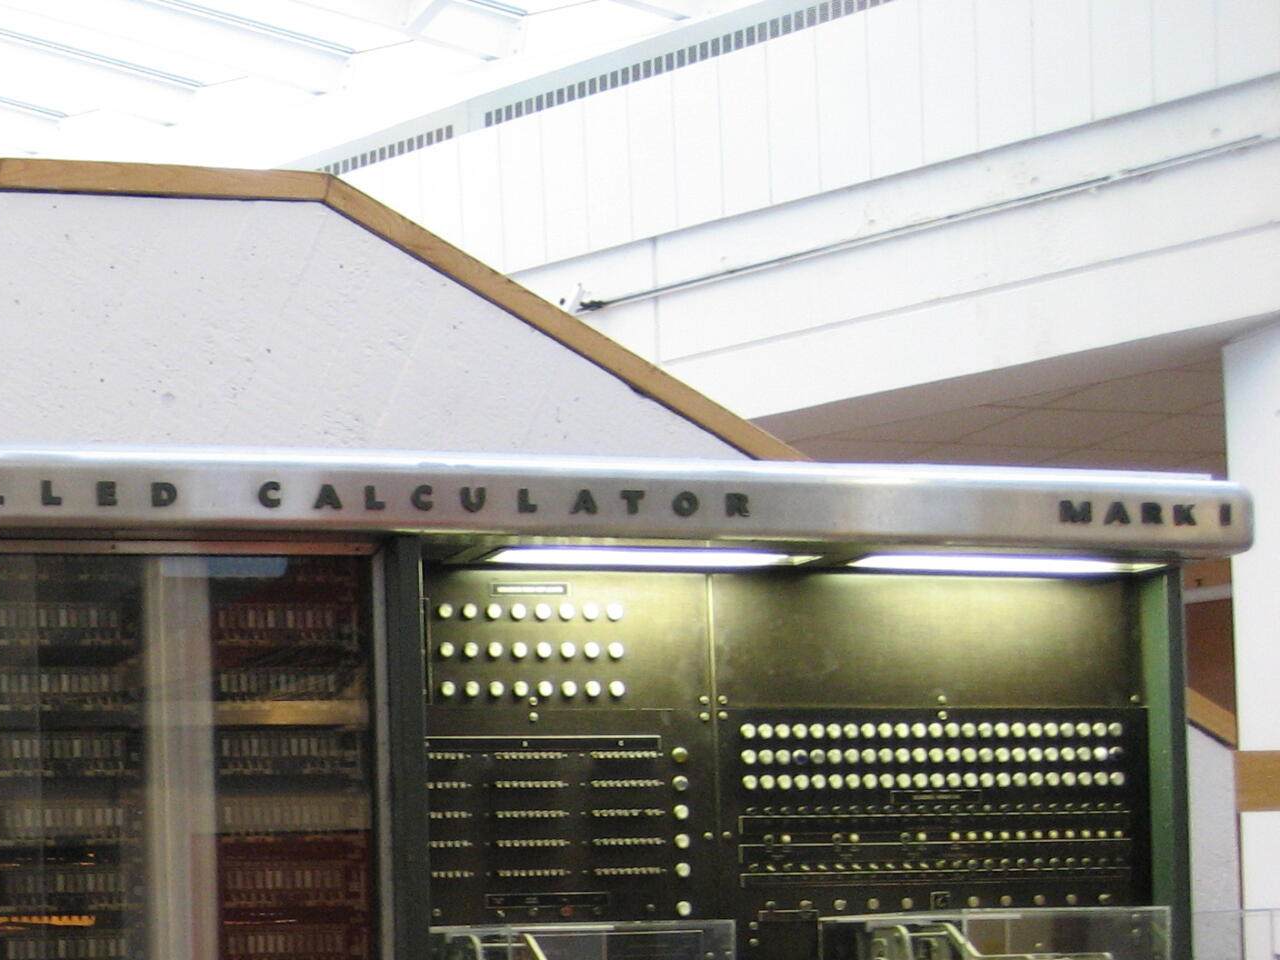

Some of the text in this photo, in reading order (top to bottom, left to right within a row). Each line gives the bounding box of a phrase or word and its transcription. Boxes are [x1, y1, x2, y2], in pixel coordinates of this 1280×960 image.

[257, 480, 751, 519] CALCULATOR
[1059, 499, 1197, 527] MARK
[1219, 503, 1232, 527] I
